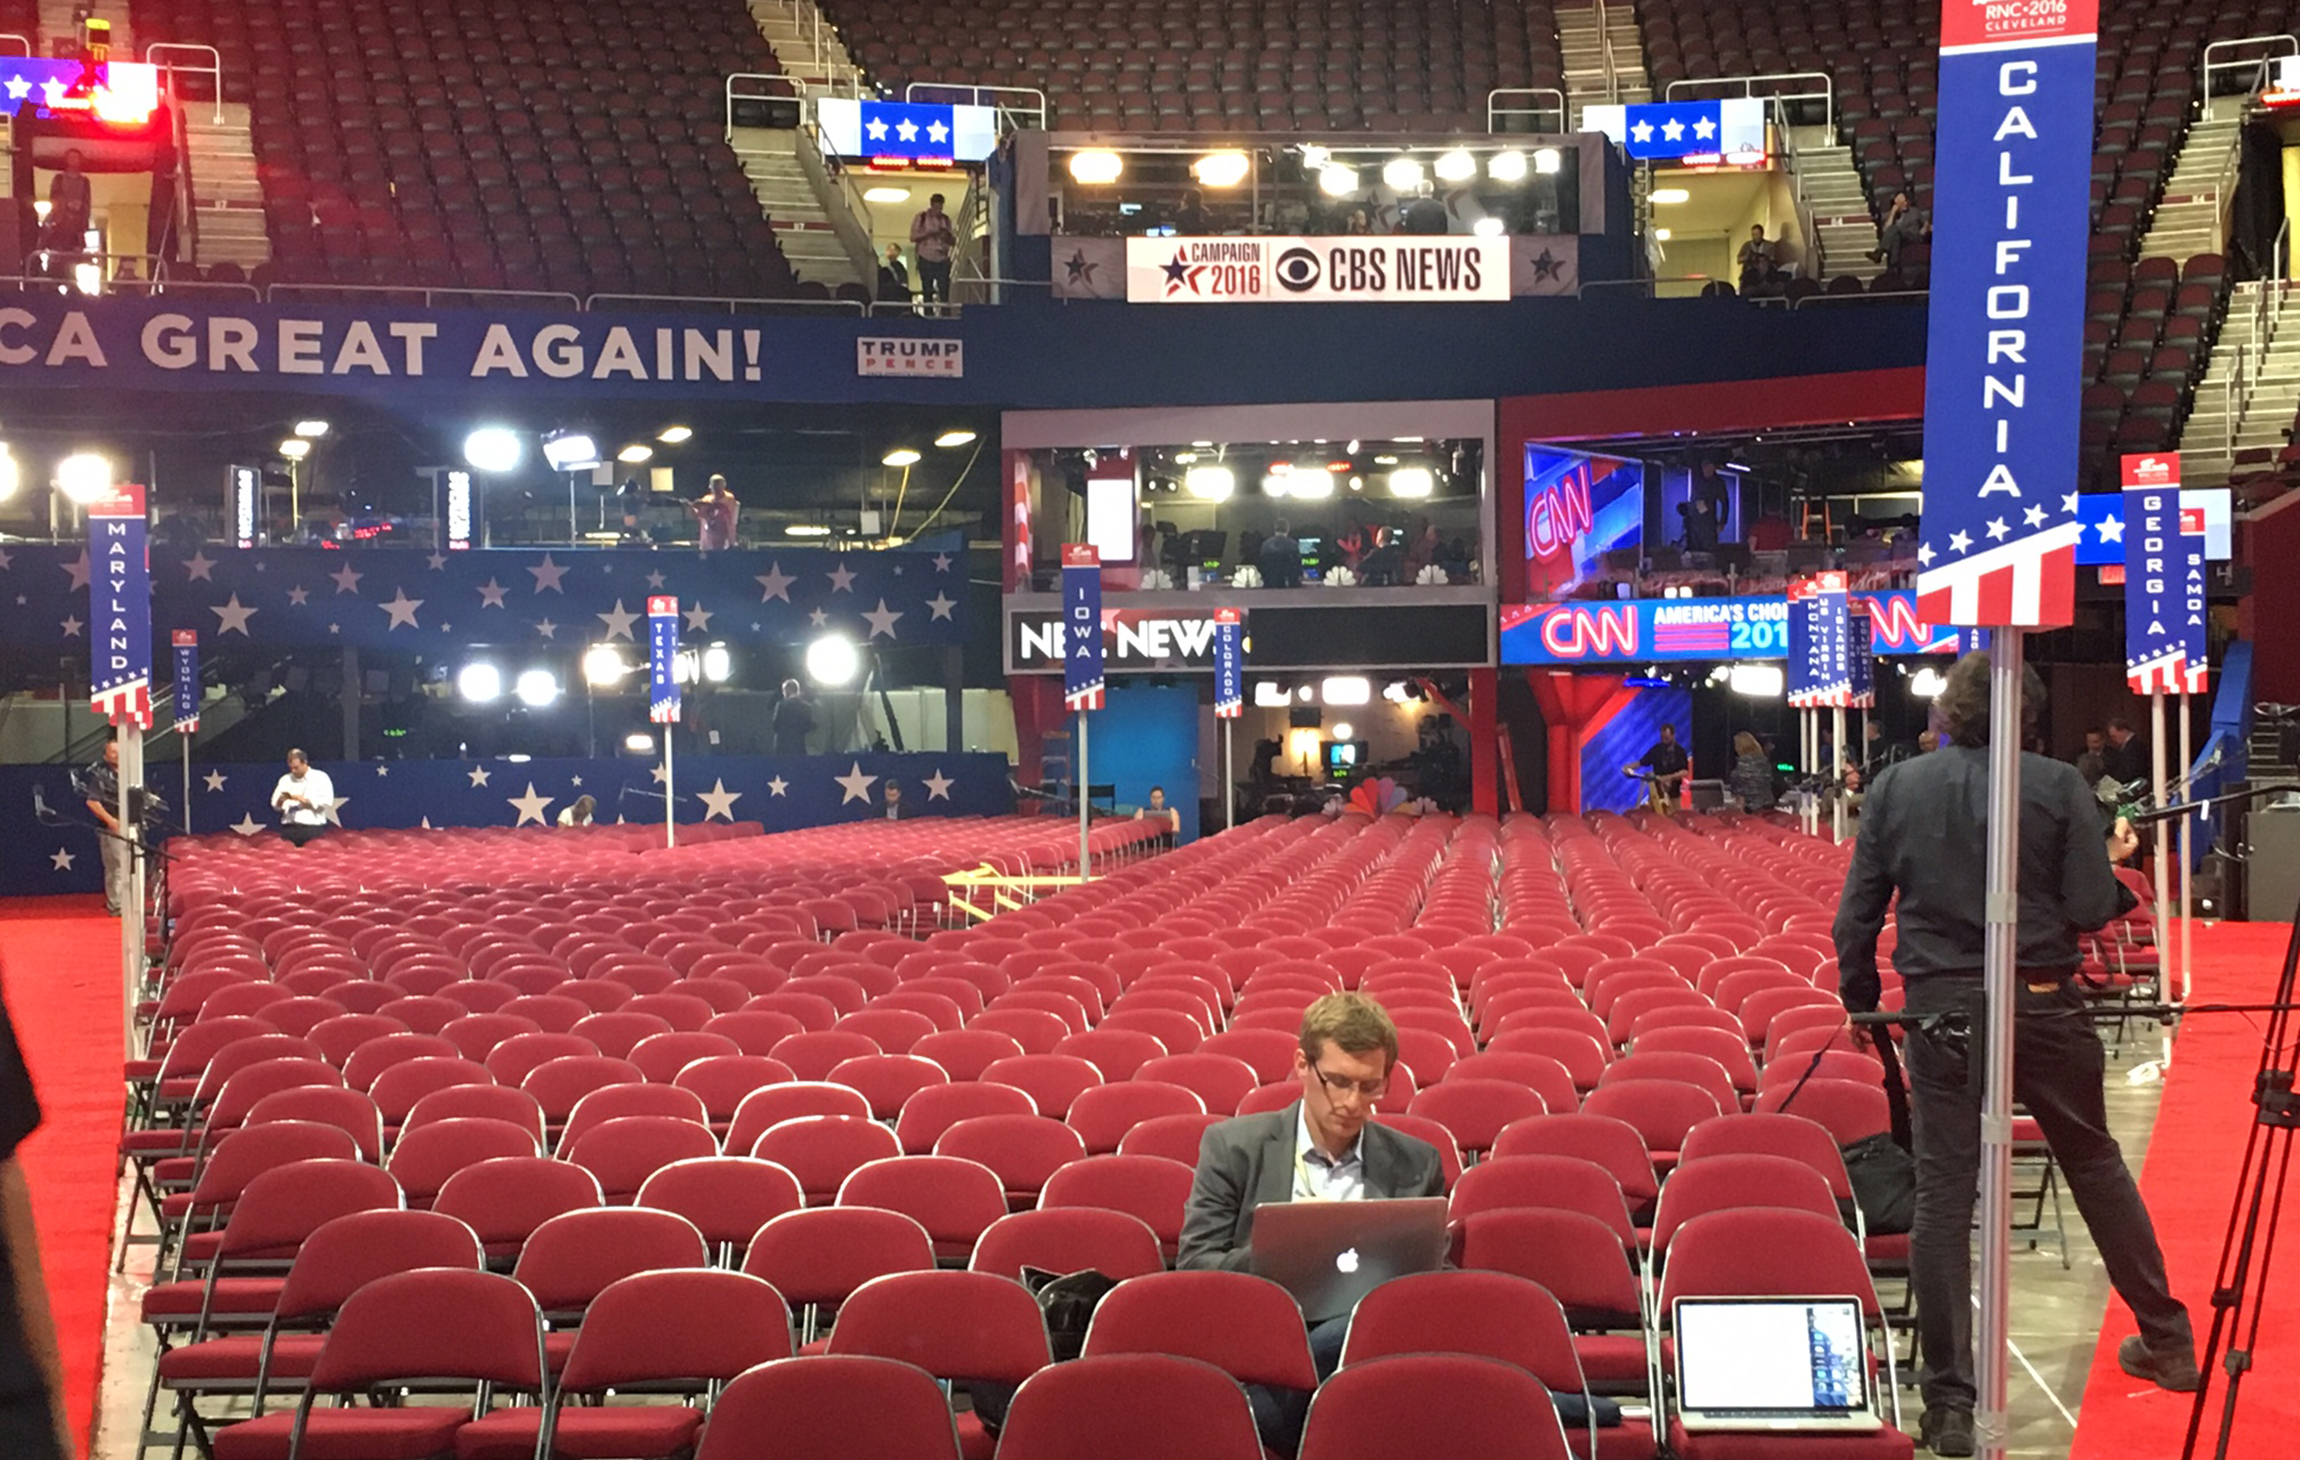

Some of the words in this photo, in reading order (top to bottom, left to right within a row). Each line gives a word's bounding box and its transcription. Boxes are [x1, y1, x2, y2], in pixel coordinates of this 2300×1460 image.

[1985, 15, 2067, 32] CLEVELAND
[1191, 242, 1261, 263] CAMPAIGN
[1210, 264, 1261, 295] 2016
[1329, 247, 1387, 292] CBS
[1396, 247, 1482, 292] NEWS
[1977, 60, 2039, 499] CALIFORNIA
[140, 312, 438, 376] GREAT
[470, 323, 762, 382] AGAIN!
[861, 341, 960, 357] TRUMP
[866, 358, 955, 370] PENCE
[1529, 462, 1593, 565] CNN
[108, 522, 128, 669] MARYLAND
[2143, 495, 2166, 635] GEORGIA
[2187, 553, 2203, 625] SAMOA
[1073, 587, 1092, 659] IOWA
[1116, 618, 1217, 659] NEW
[1541, 605, 1638, 660] CNN
[1653, 603, 1745, 624] AMERICA'S
[1747, 602, 1789, 622] CHOI
[1730, 621, 1789, 650] 201
[1808, 602, 1820, 676] MONTANA
[1835, 606, 1846, 672] ISLANDS
[180, 648, 192, 710] WYOMING
[655, 622, 665, 685] TEXAS
[1222, 625, 1234, 697] COLORADO
[1820, 625, 1831, 681] VIRGIN
